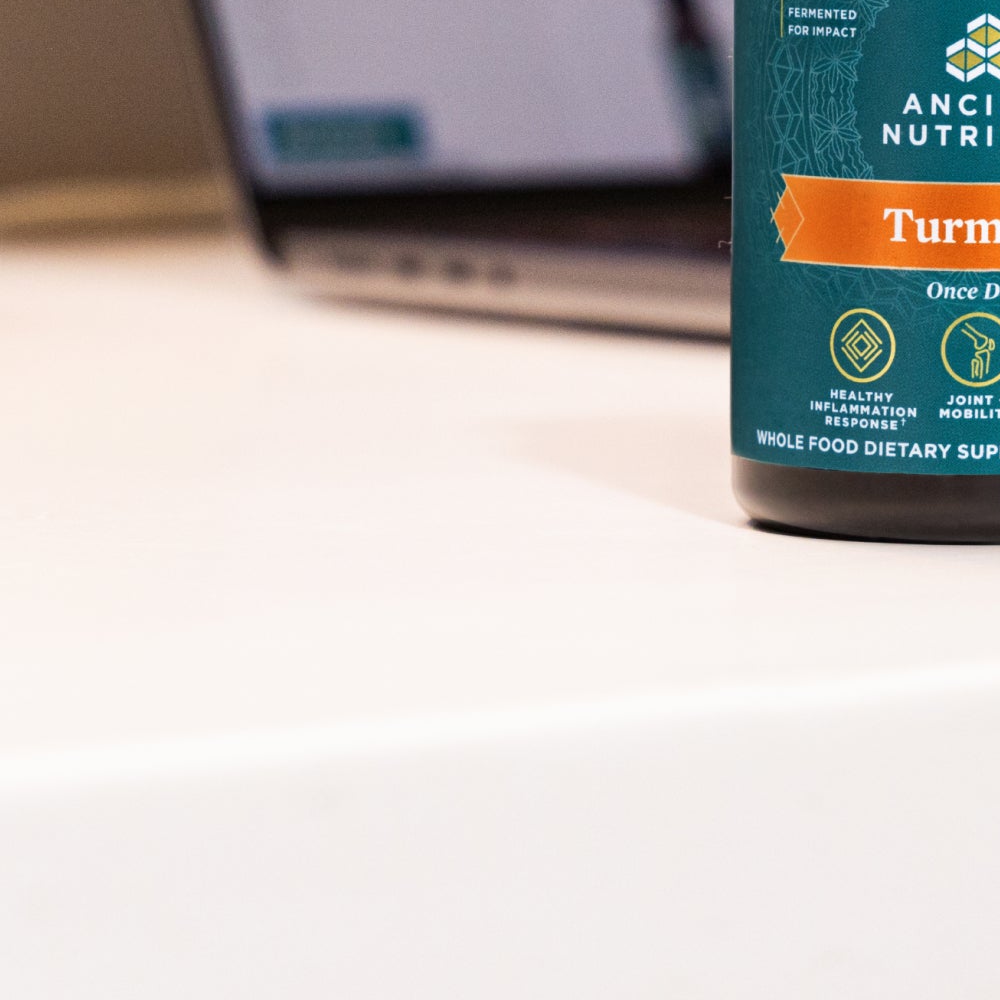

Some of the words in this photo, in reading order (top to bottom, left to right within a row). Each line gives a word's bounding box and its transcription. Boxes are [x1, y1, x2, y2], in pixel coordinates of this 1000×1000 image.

[788, 7, 858, 20] FERMENTED
[788, 24, 810, 36] FOR
[812, 26, 857, 38] IMPACT
[926, 281, 979, 301] Once
[830, 388, 894, 403] HEALTHY
[946, 394, 994, 406] JOINT
[810, 400, 917, 418] INFLAMMATION
[756, 429, 804, 450] WHOLE
[808, 435, 859, 456] FOOD
[864, 440, 951, 459] DIETARY
